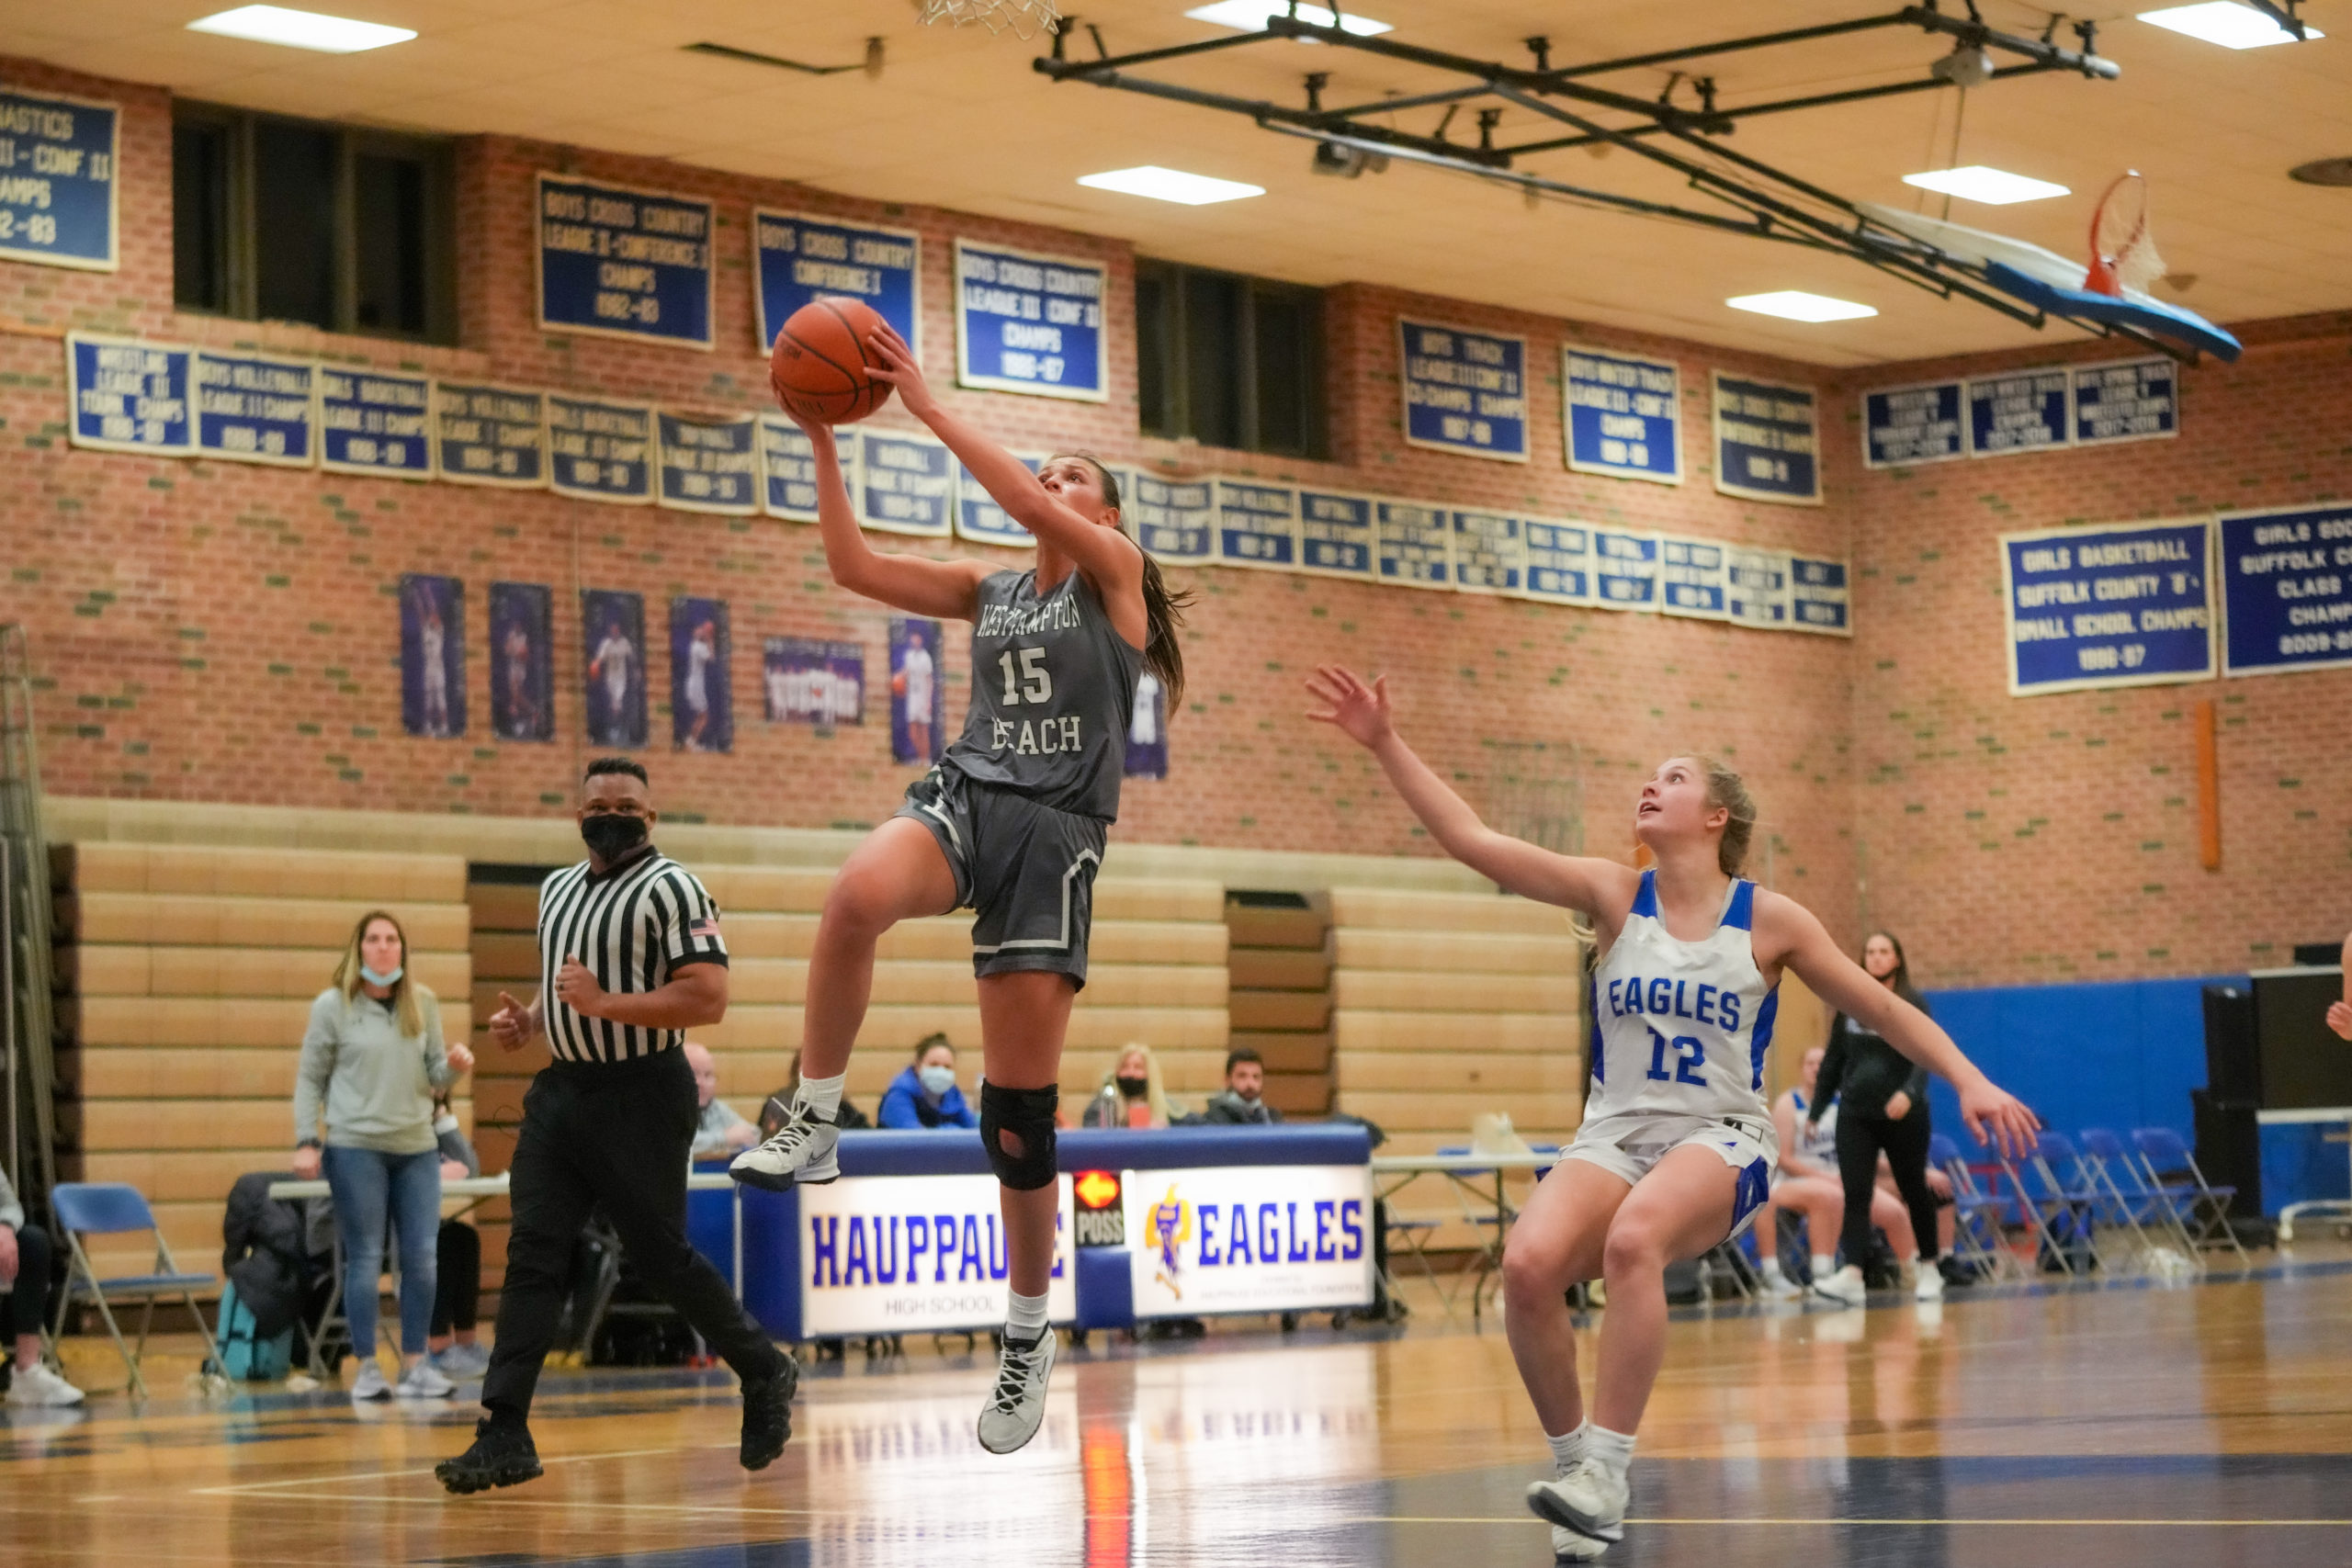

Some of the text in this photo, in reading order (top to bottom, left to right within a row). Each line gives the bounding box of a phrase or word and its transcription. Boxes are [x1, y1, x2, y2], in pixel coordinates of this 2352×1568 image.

[600, 262, 656, 294] CHAMPS
[1002, 321, 1061, 353] CHAMPS
[2254, 522, 2311, 546] GIRLS
[2021, 538, 2190, 573] GIRLS BASKETBALL
[2239, 549, 2327, 575] SUFFOLK
[2018, 581, 2090, 608] SUFFOLK
[2094, 575, 2160, 601] COUNTY
[2277, 574, 2342, 599] CLASS
[2073, 612, 2138, 637] SCHOOL
[2141, 606, 2208, 632] CHAMPS
[999, 647, 1053, 706] 15
[1610, 976, 1741, 1032] EAGLES
[1646, 1024, 1708, 1088] 12
[1078, 1209, 1125, 1246] POSS
[1197, 1200, 1363, 1267] EAGLES
[811, 1213, 1065, 1287] HAUPPAU
[886, 1295, 997, 1316] HIGH SCHOOL
